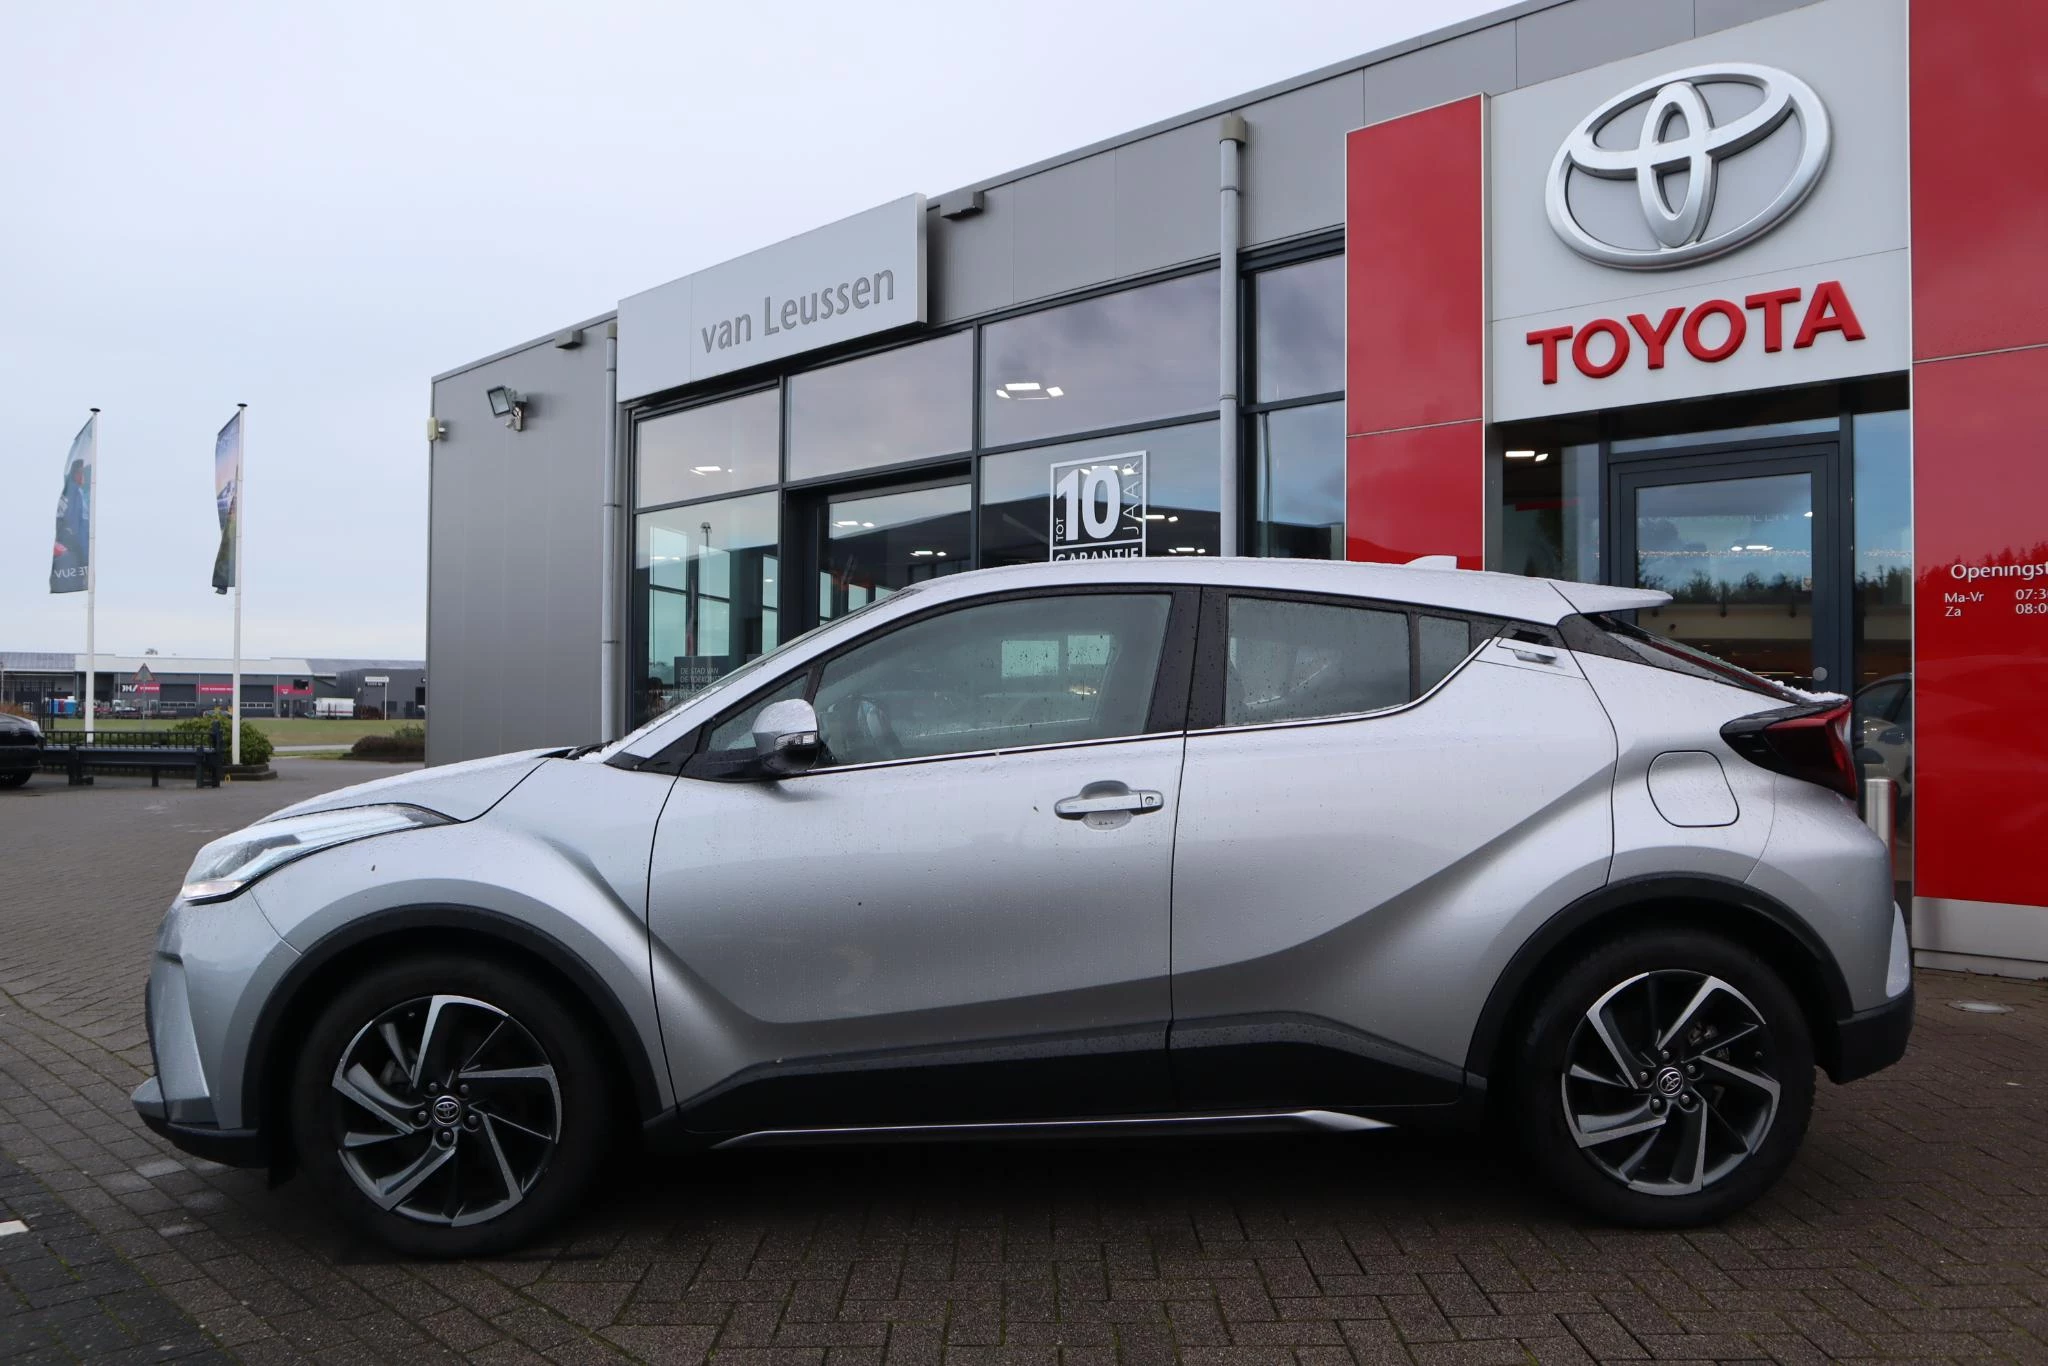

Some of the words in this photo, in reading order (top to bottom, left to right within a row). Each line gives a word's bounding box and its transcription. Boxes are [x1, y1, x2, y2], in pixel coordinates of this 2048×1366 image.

[701, 313, 752, 354] van
[764, 269, 894, 337] Leussen
[1526, 281, 1866, 385] TOYOTA
[1055, 517, 1065, 542] TOT
[1056, 465, 1121, 541] 10
[1122, 461, 1140, 536] JAAR
[1944, 591, 1984, 603] Ma-Vr
[2015, 588, 2048, 601] 07:3
[1945, 606, 1962, 617] Za
[2015, 602, 2048, 615] 08:0
